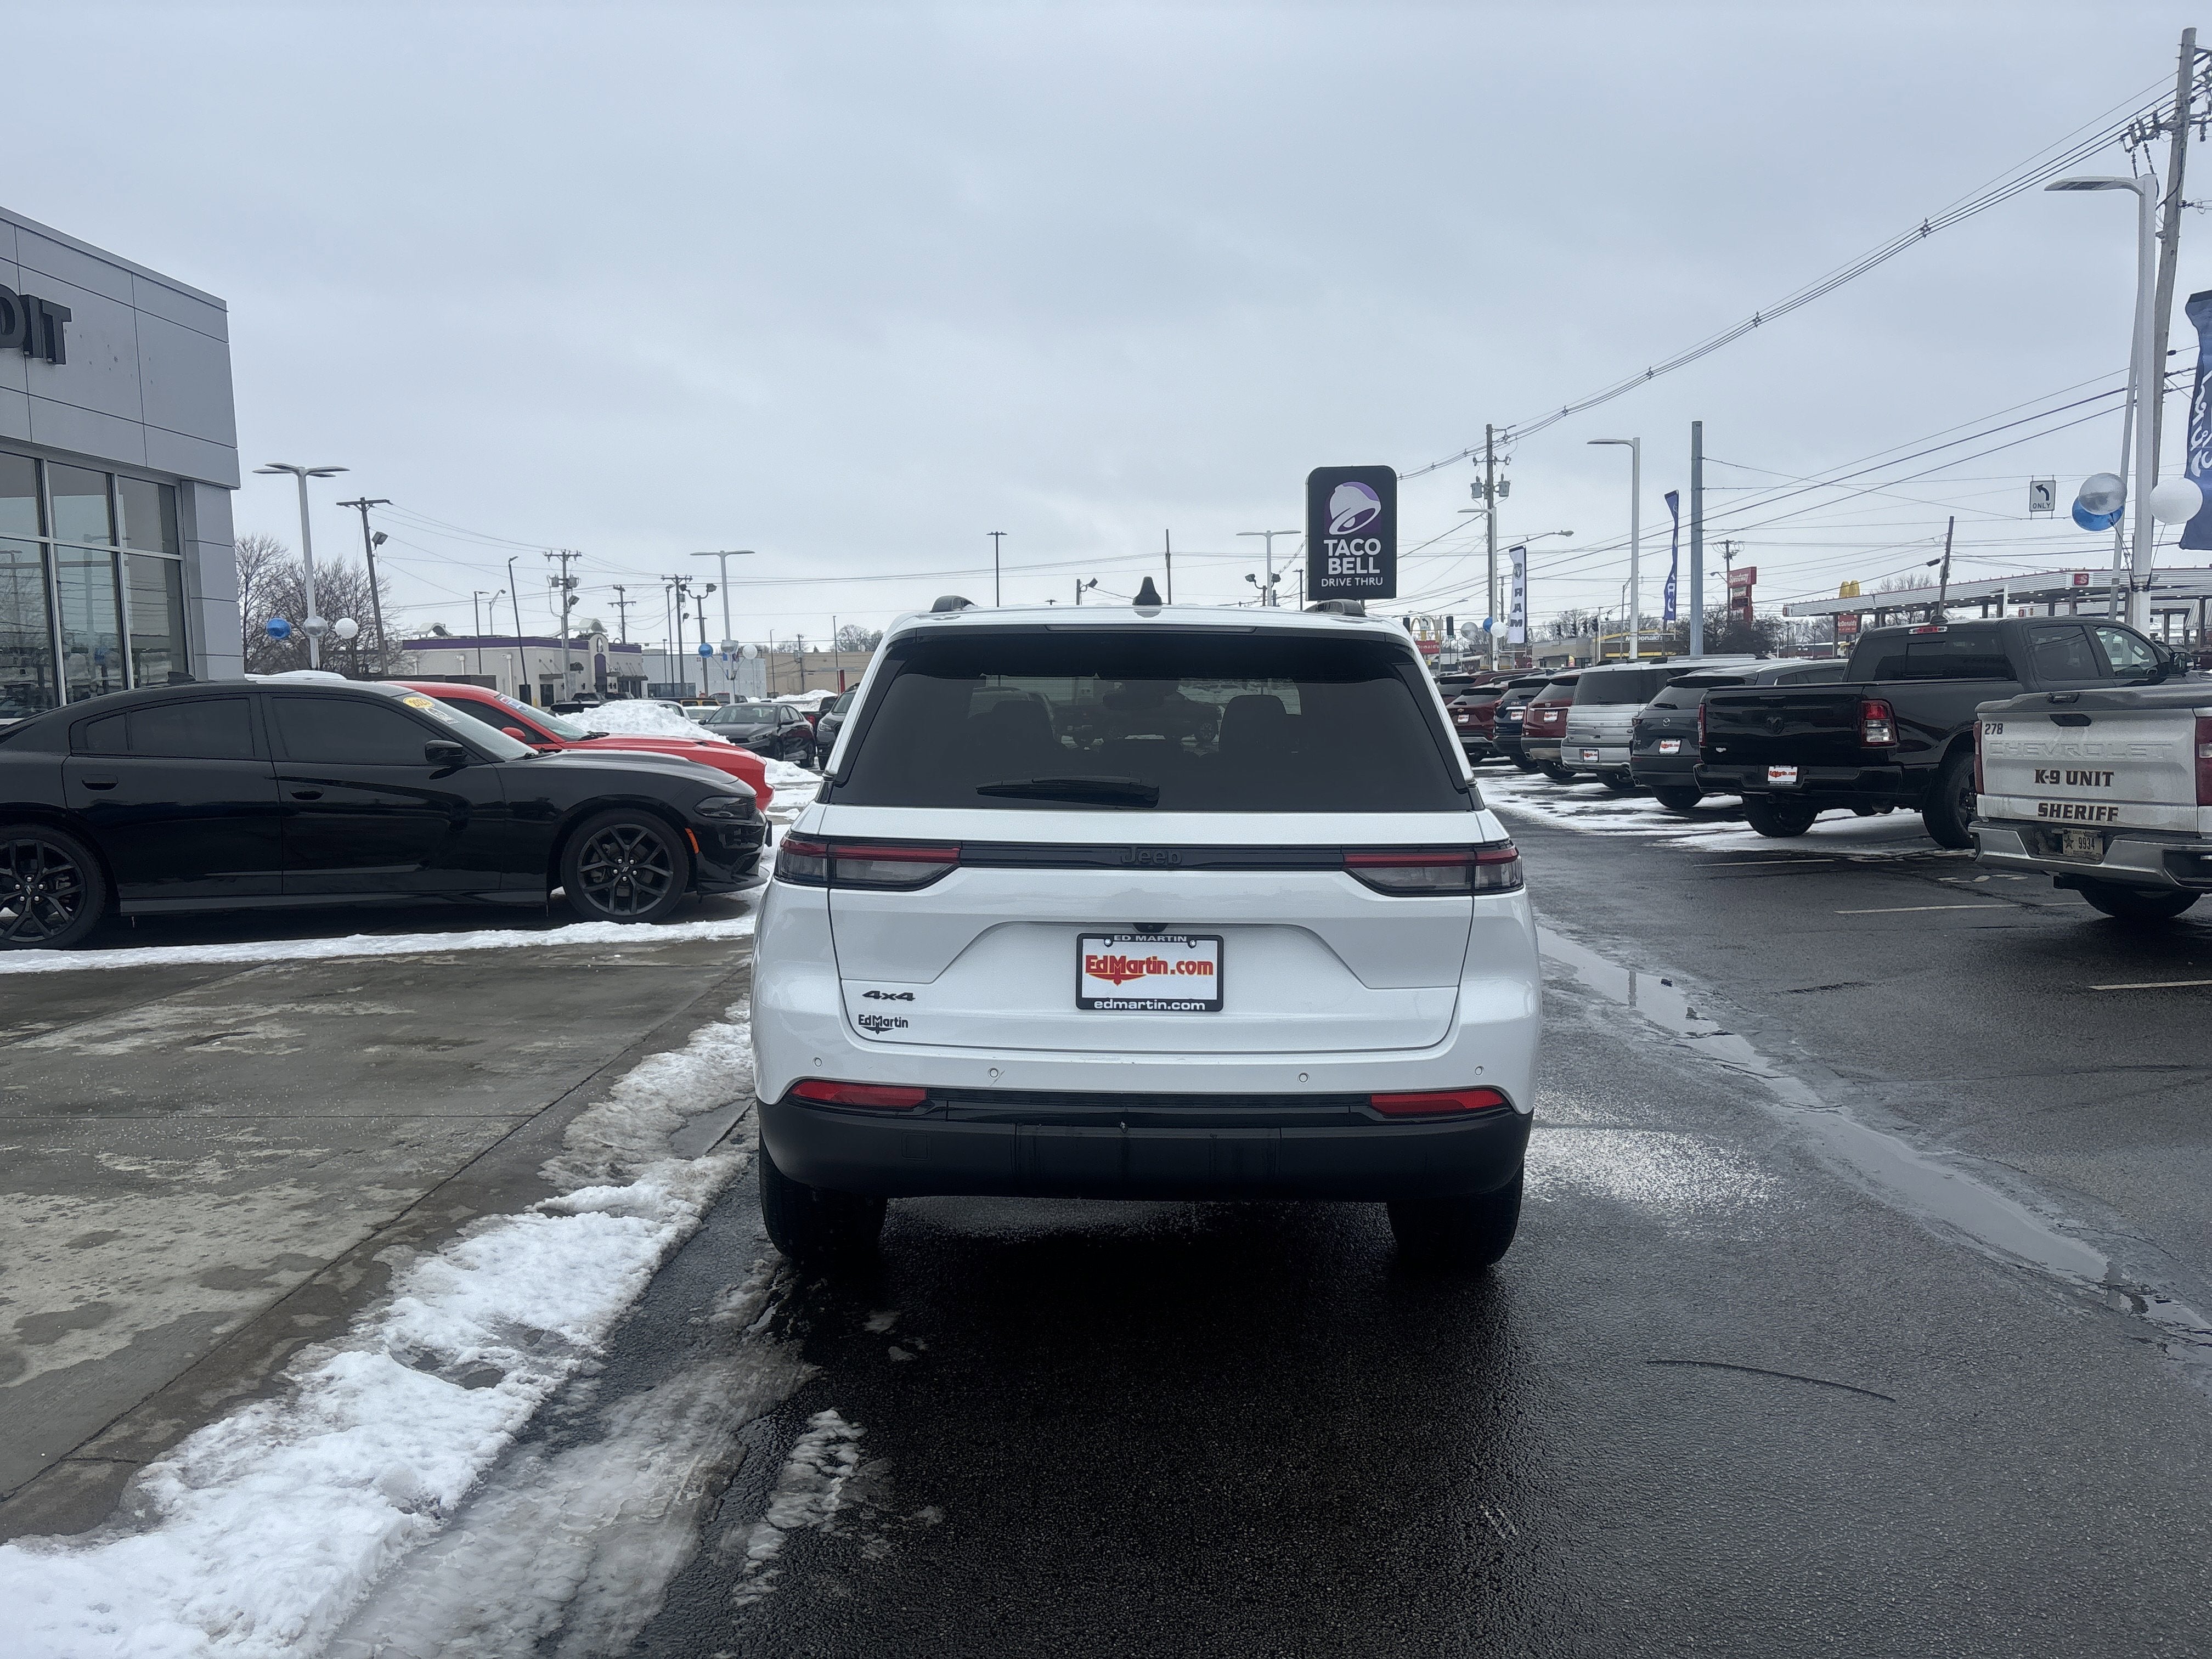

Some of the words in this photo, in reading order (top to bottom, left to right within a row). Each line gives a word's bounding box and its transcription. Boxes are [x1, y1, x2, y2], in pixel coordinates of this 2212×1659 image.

[1324, 538, 1381, 556] TACO
[1328, 557, 1380, 574] BELL
[1321, 578, 1352, 587] DRIVE
[1355, 577, 1383, 586] THRU
[1985, 723, 2003, 735] 278
[1989, 743, 2172, 758] CHEVROLET
[2035, 769, 2060, 785] K-9
[2066, 770, 2114, 787] UNIT
[2038, 803, 2119, 821] SHERIFF
[2079, 837, 2095, 850] 9934
[1121, 847, 1182, 866] Jeep
[1085, 955, 1214, 977] EdMartin.com
[862, 991, 916, 1001] 4x4
[1094, 999, 1205, 1010] edmartin.com
